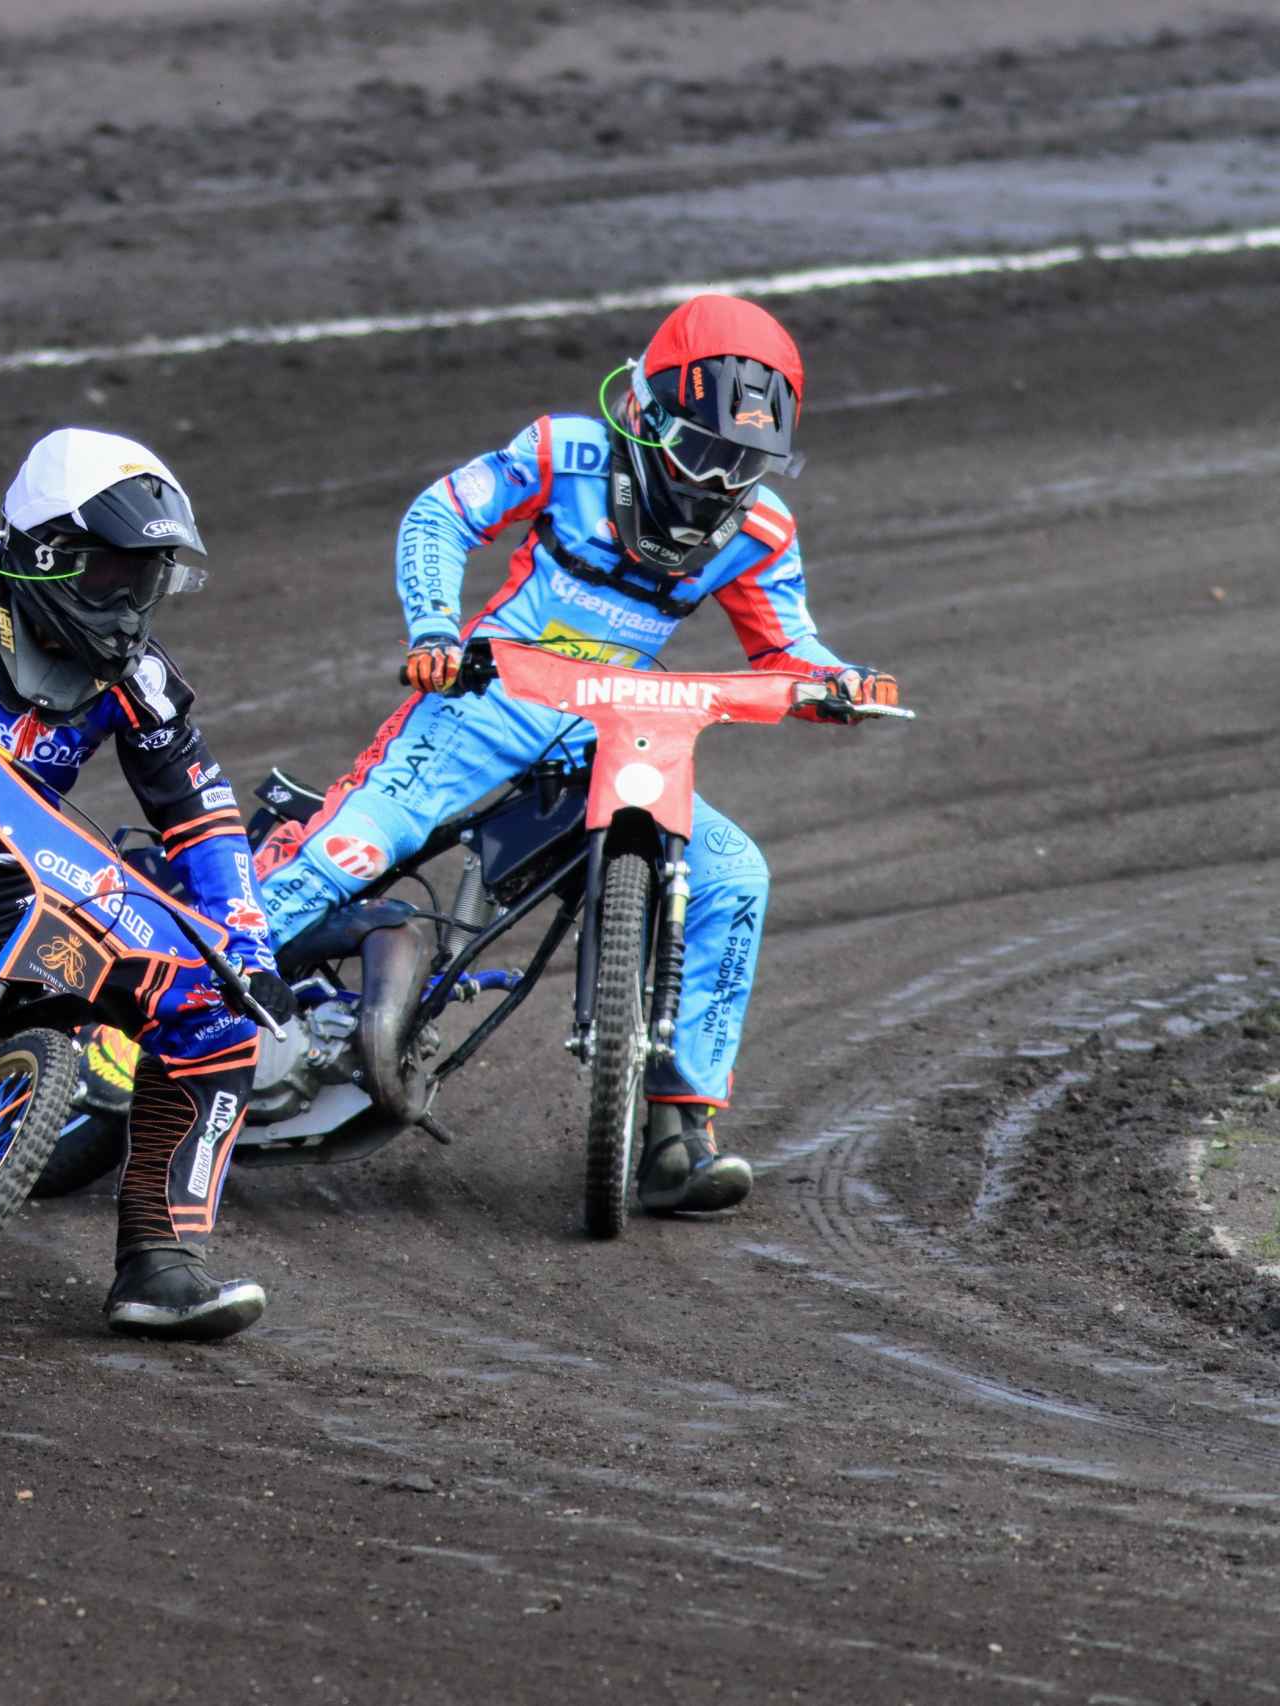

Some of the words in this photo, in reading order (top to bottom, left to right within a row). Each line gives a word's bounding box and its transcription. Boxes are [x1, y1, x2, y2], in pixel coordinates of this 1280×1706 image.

[564, 440, 609, 473] ID
[576, 677, 720, 709] INPRINT
[35, 850, 97, 897] OLE'S
[107, 900, 155, 948] OLIE
[704, 936, 738, 1034] PRODUCTION
[710, 1018, 731, 1067] STEEL
